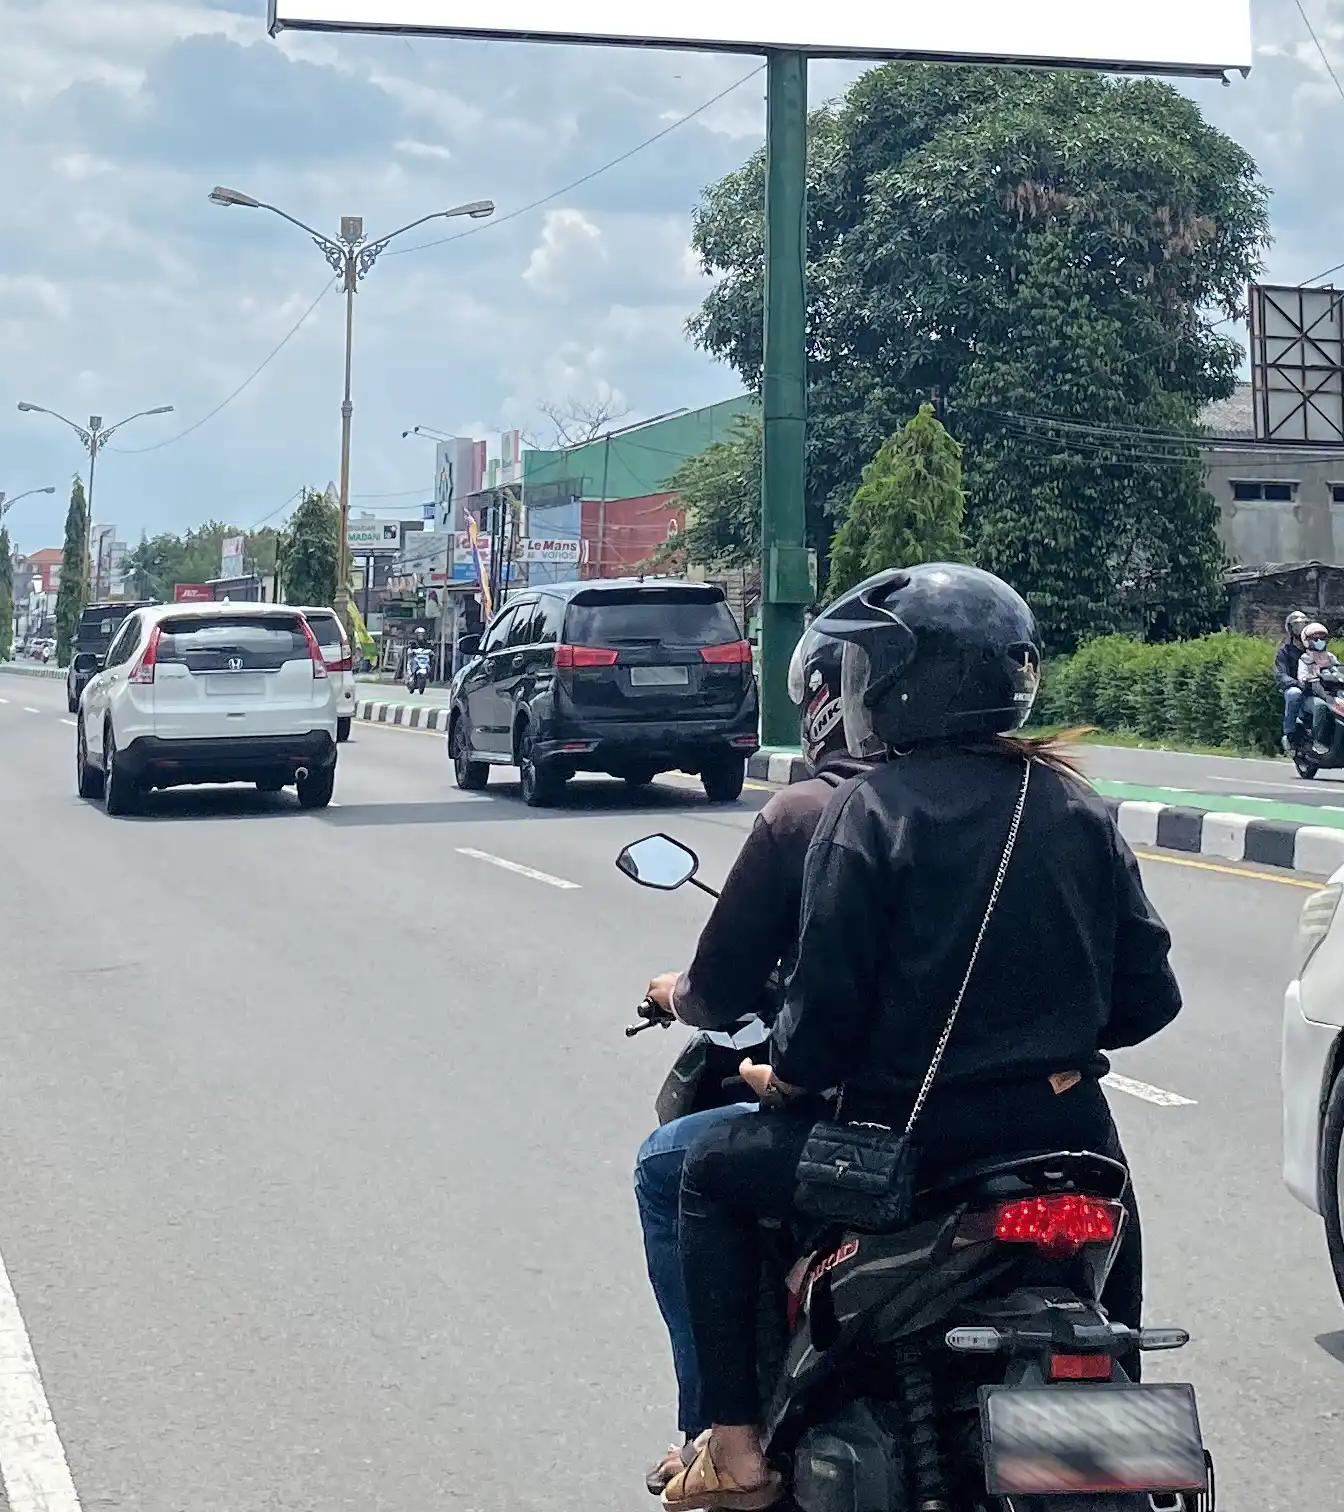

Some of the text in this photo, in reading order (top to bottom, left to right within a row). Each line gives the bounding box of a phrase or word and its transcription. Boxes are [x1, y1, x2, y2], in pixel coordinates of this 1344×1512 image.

[527, 540, 577, 551] Le Mans
[813, 698, 843, 738] INK
